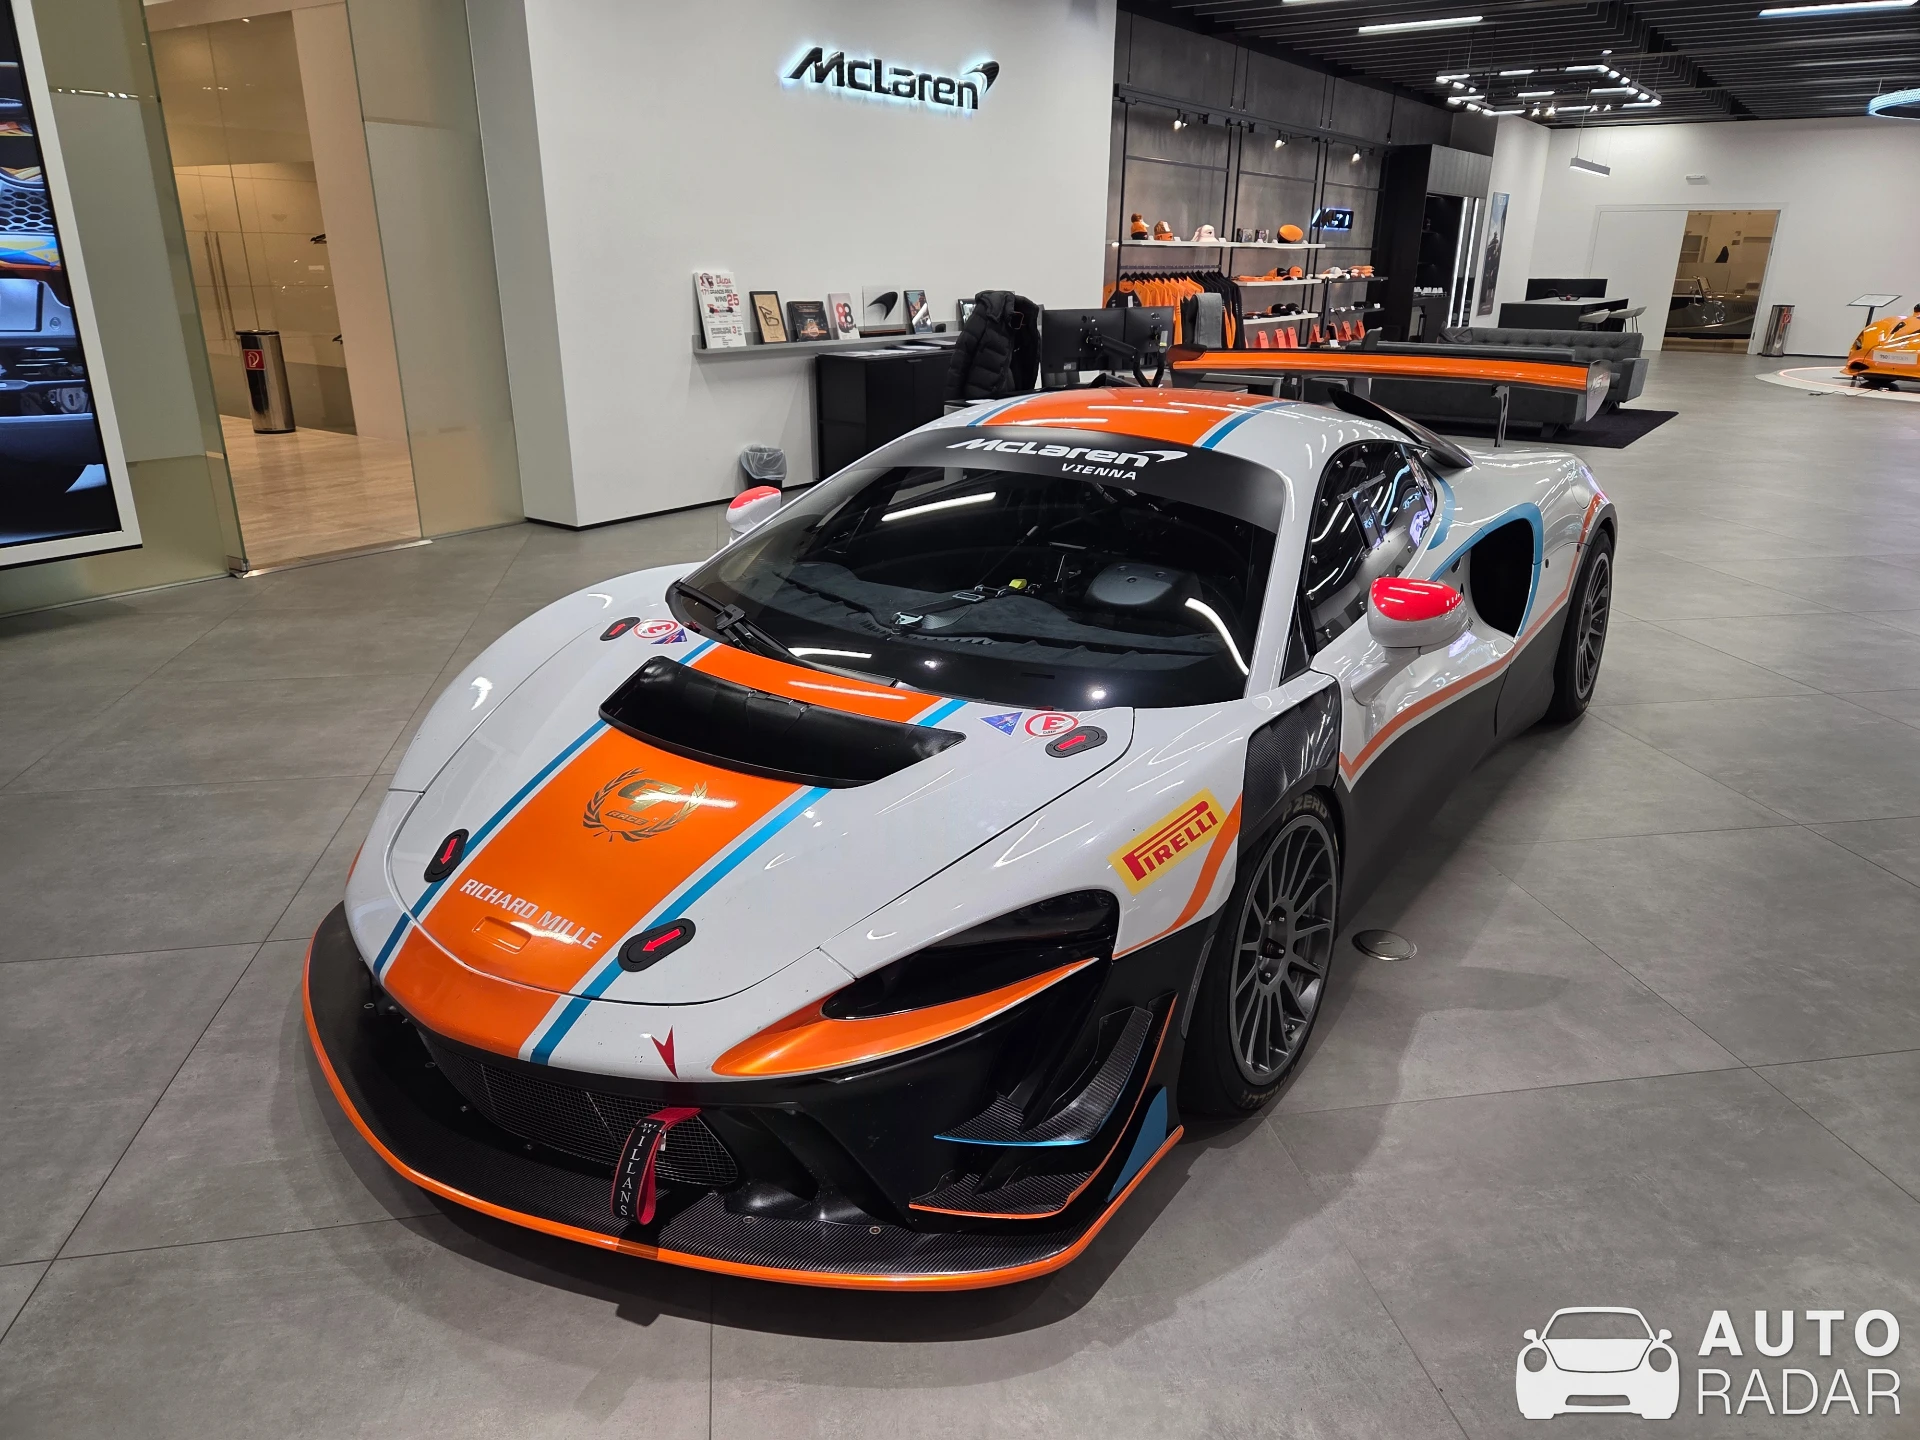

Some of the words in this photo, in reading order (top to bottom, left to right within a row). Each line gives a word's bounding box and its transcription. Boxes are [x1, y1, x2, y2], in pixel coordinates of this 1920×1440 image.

[785, 46, 979, 109] McLaren
[727, 294, 740, 306] 25
[946, 438, 1150, 468] McLaren
[1061, 462, 1137, 481] VIENNA
[1042, 716, 1066, 731] E
[608, 810, 646, 825] RACE
[1122, 800, 1219, 881] PIRELLI
[459, 878, 539, 919] RICHARD
[536, 910, 603, 950] MILLE
[620, 1122, 657, 1216] WILLANS
